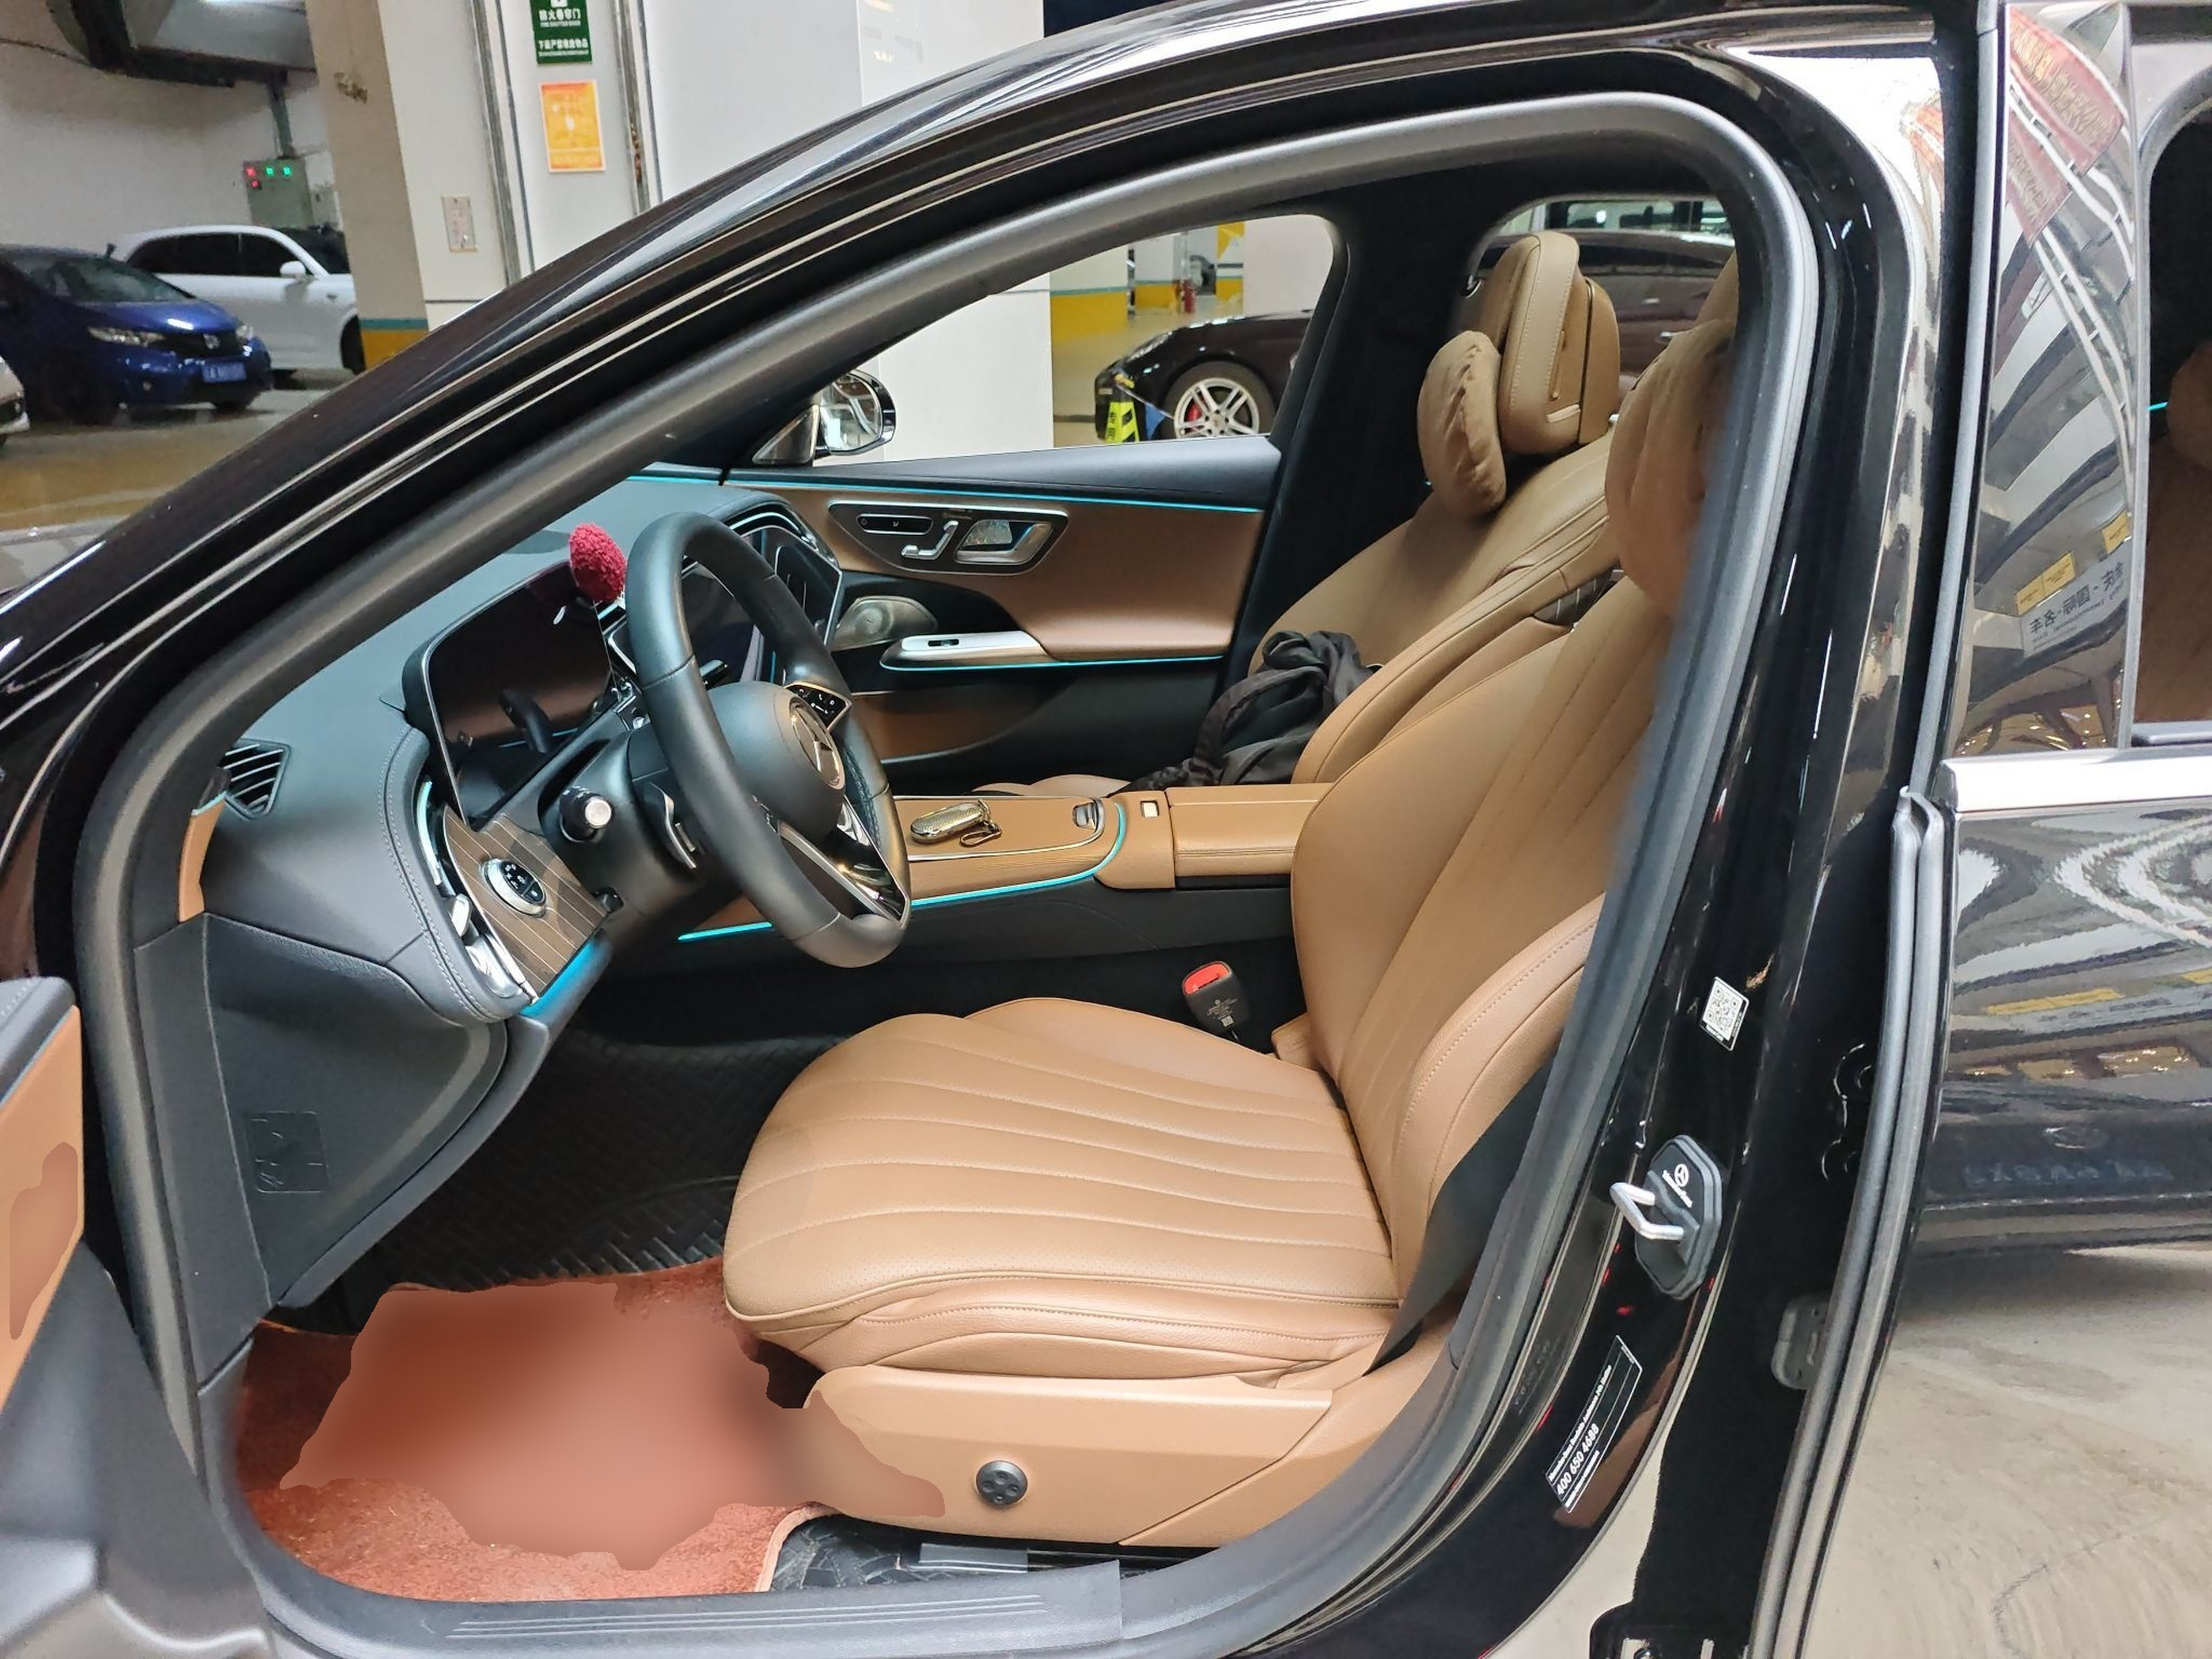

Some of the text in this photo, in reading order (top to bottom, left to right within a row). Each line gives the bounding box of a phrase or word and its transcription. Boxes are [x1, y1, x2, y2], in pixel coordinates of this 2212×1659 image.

[1557, 1472, 1571, 1495] 400
[1570, 1451, 1584, 1475] 650
[1582, 1423, 1599, 1453] 4688
